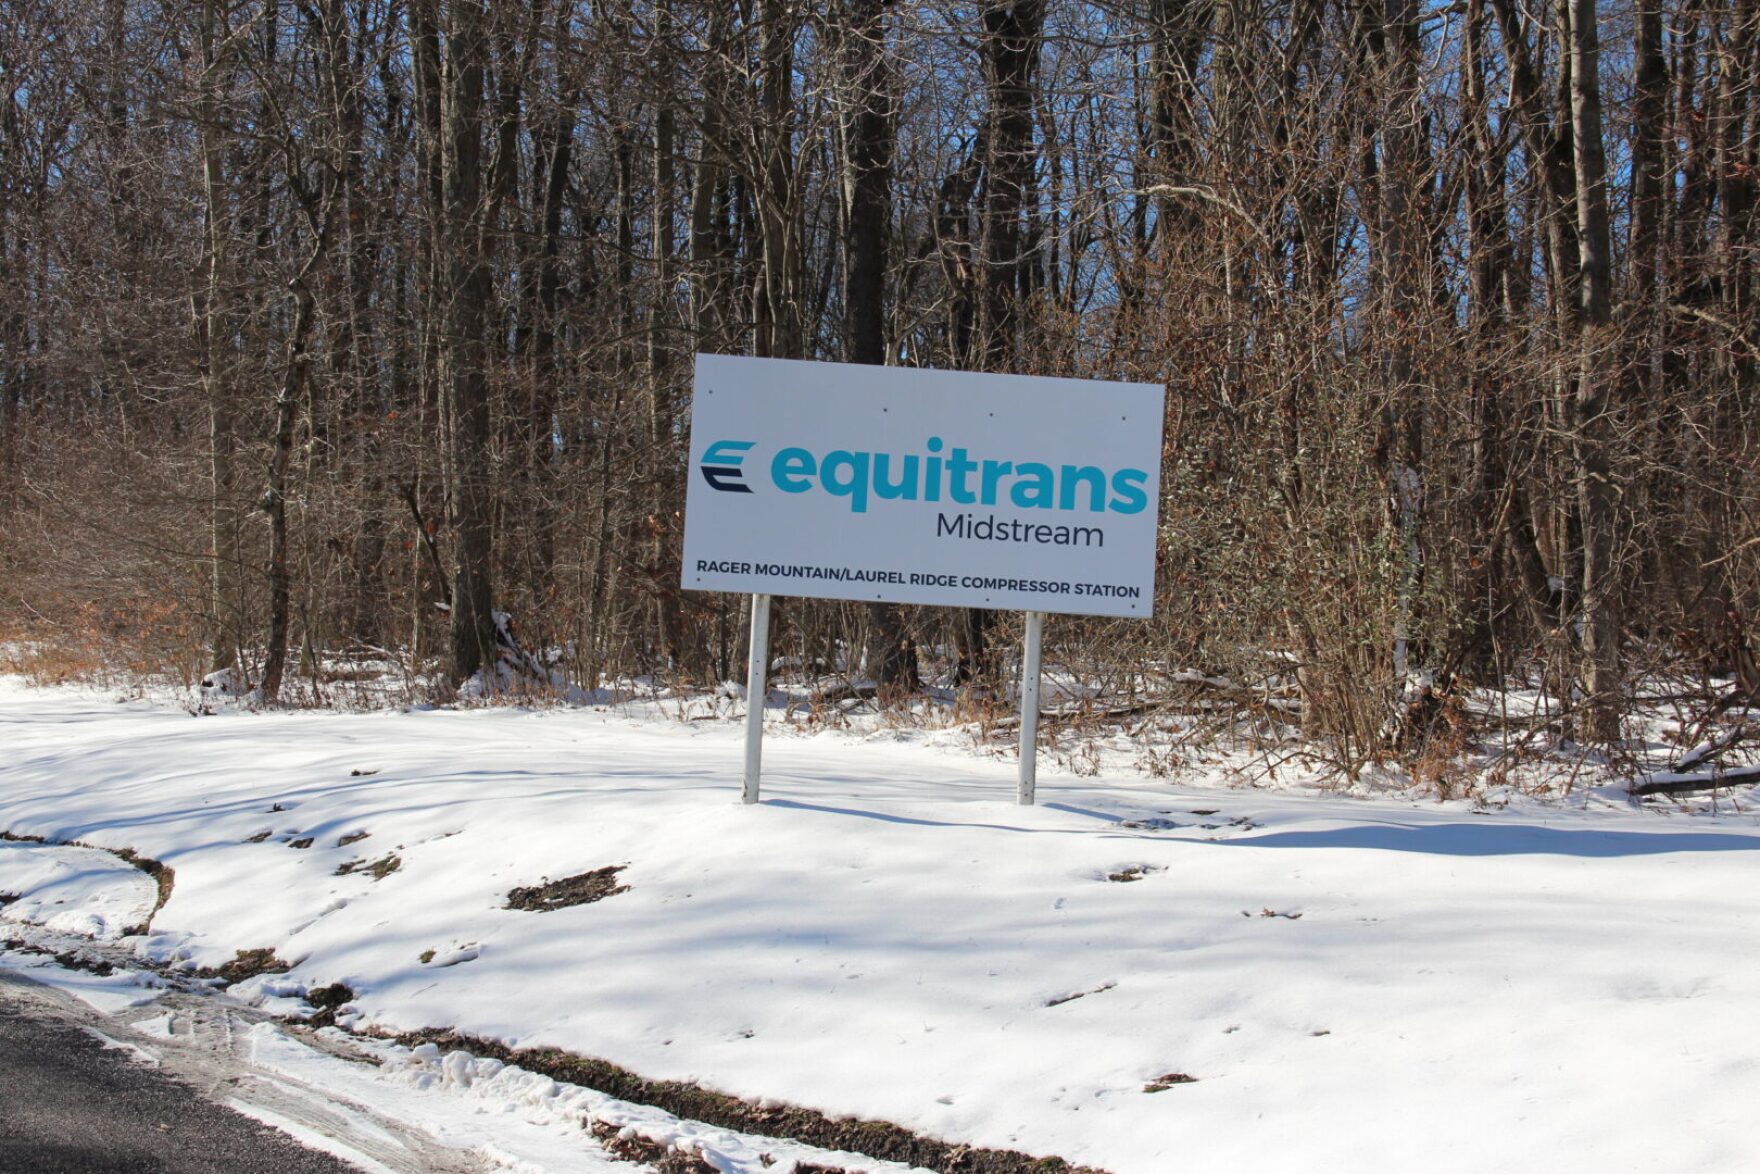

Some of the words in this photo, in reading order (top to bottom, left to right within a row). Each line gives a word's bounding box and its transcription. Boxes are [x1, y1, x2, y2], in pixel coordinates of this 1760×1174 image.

[770, 436, 1149, 515] equitrans
[936, 512, 1104, 547] Midstream
[696, 560, 751, 575] RAGER
[754, 563, 906, 585] MOUNTAIN/LAUREL
[910, 573, 958, 588] RIDGE
[961, 576, 1070, 595] COMPRESSOR
[1074, 583, 1140, 598] STATION
